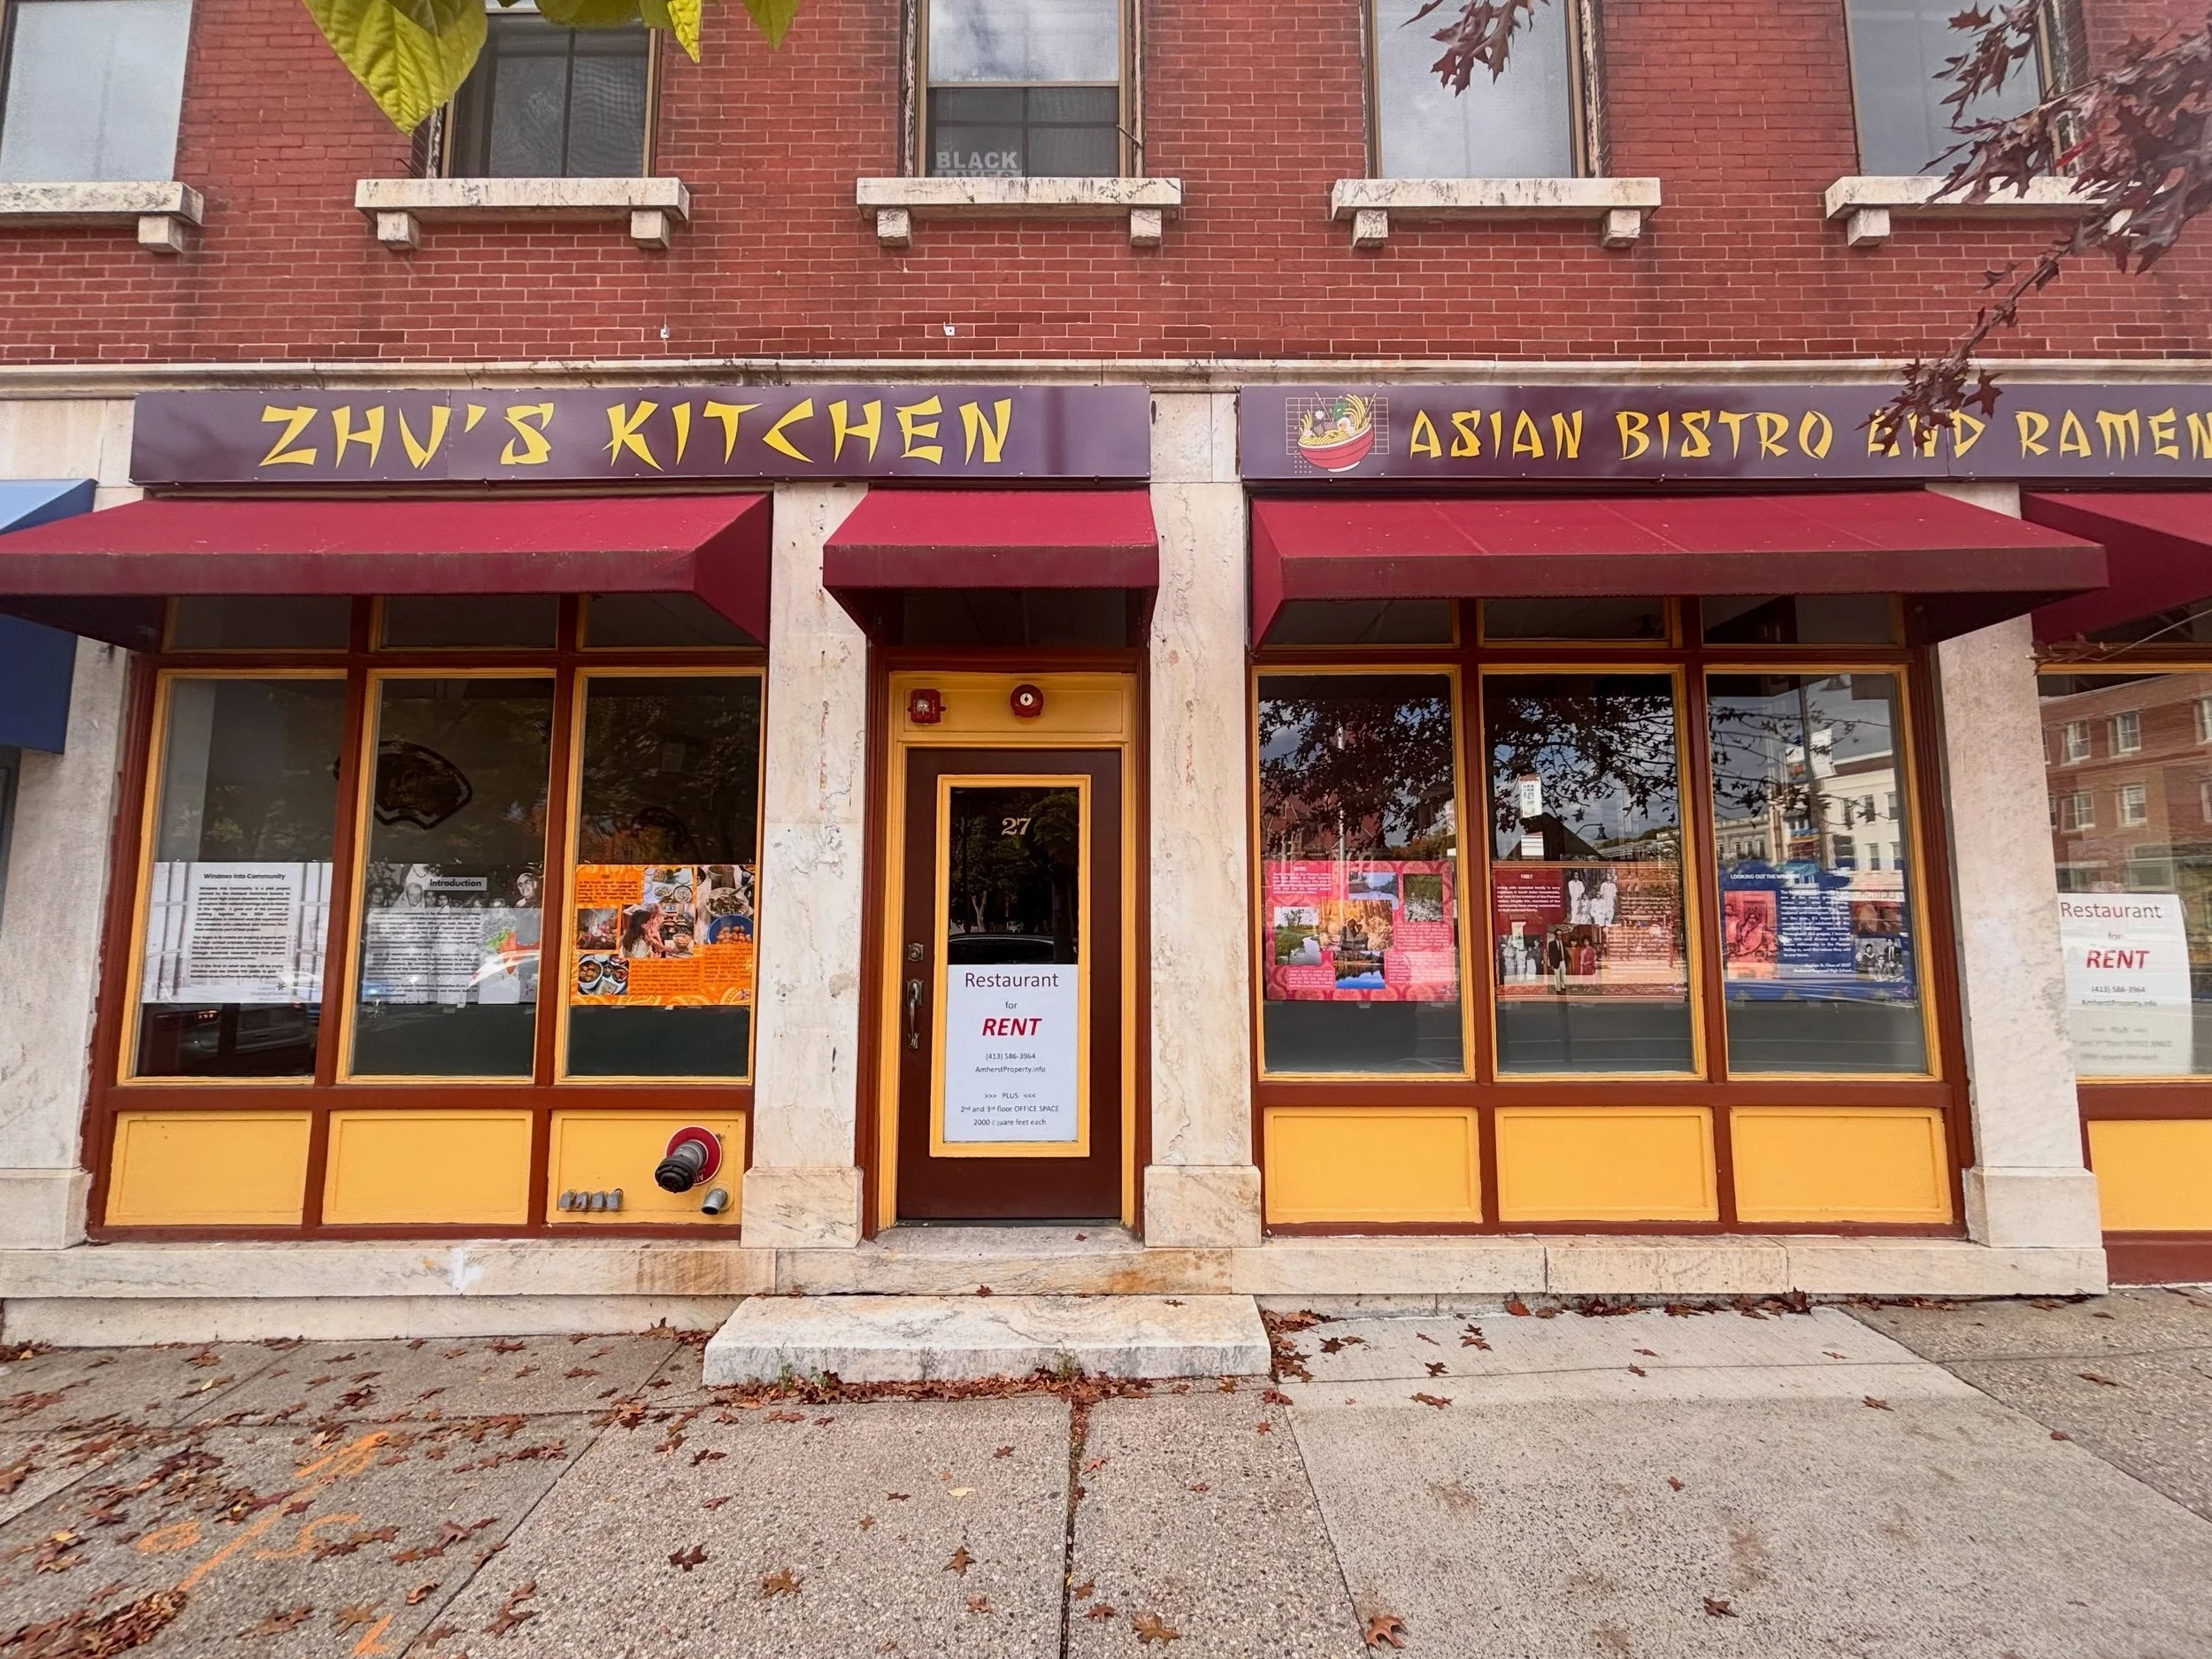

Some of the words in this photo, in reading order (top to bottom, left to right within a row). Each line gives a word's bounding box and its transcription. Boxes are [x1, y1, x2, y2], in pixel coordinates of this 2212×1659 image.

[935, 151, 1018, 169] BLACK
[603, 395, 1012, 472] KITCHEN
[1409, 409, 1583, 461] ASIAN
[1615, 409, 1834, 461] BISTRO
[2015, 406, 2212, 462] RAMEN
[1001, 817, 1032, 836] 27
[429, 878, 482, 887] Introduction
[2060, 901, 2162, 918] Restaurant
[2108, 932, 2124, 941] for
[2085, 949, 2150, 969] RENT
[964, 972, 1059, 987] Restaurant
[1005, 1000, 1018, 1010] for
[981, 1018, 1042, 1036] RENT
[986, 1052, 1003, 1061] (413)
[974, 1065, 1046, 1074] AmherstProperty.info
